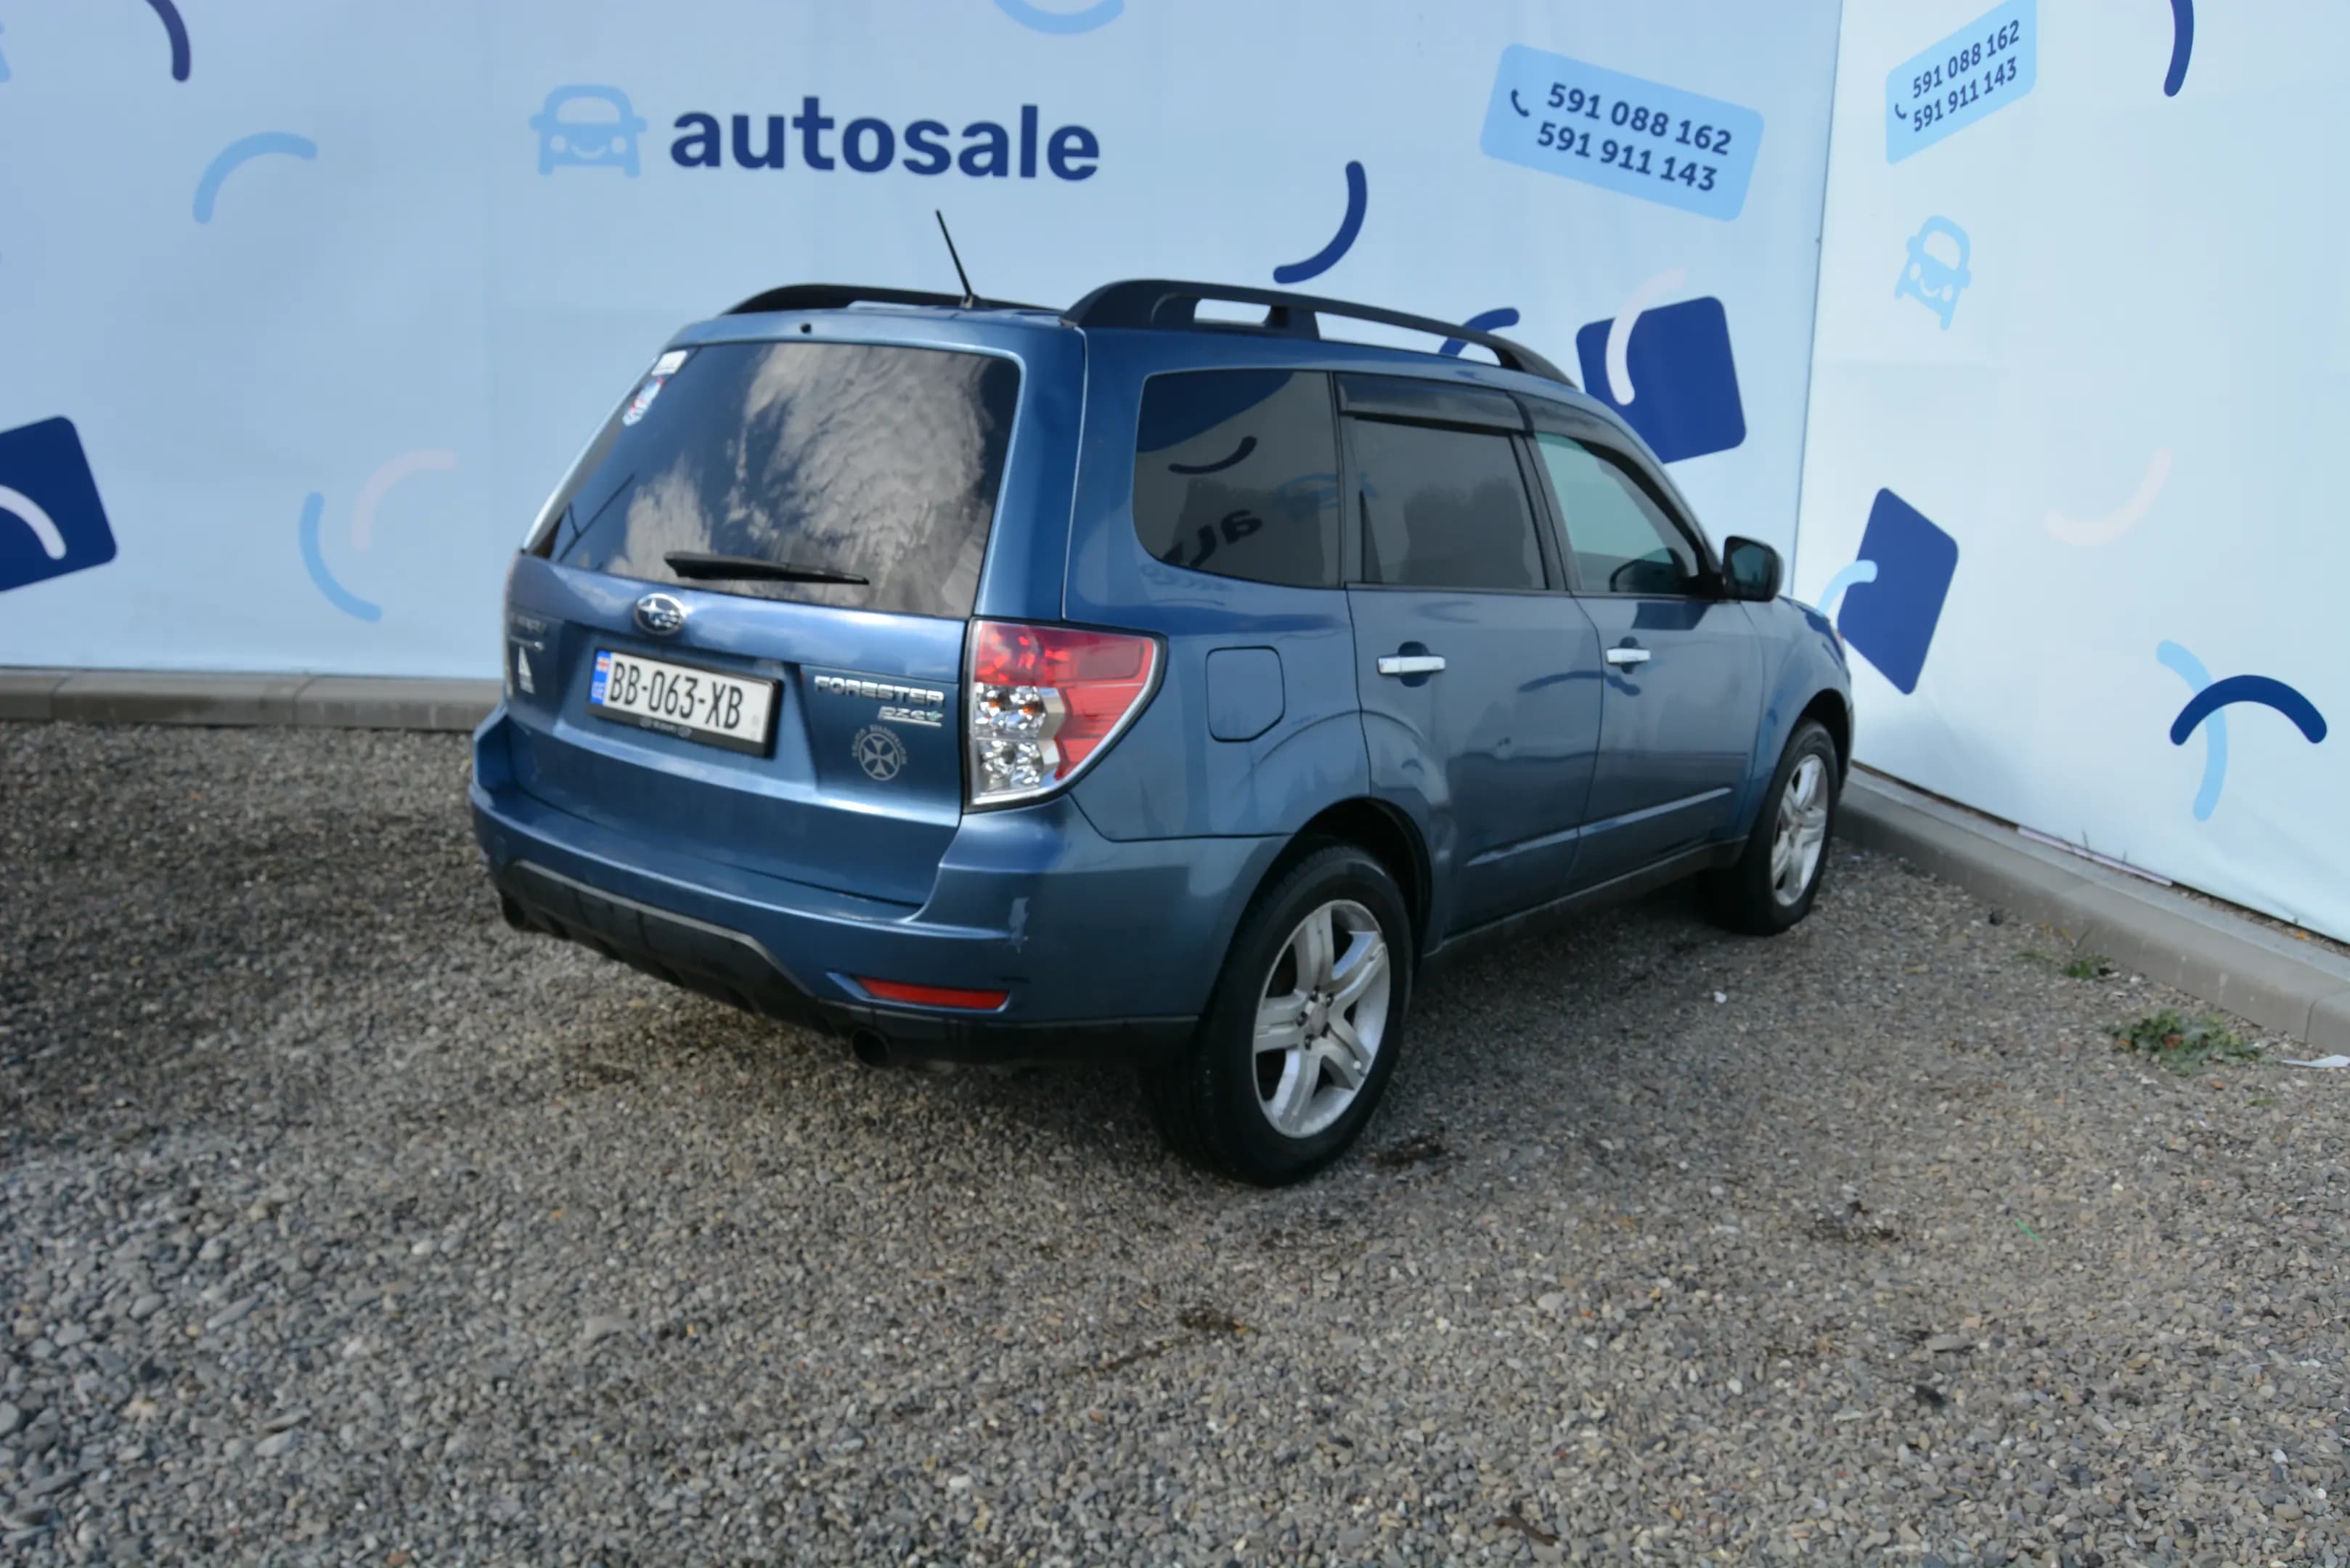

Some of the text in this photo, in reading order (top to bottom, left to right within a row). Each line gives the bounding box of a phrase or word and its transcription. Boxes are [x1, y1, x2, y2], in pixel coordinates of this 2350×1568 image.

[1912, 20, 2020, 99] 591 088 162
[1914, 56, 2017, 132] 591 911 143
[670, 96, 1100, 181] autosale
[1547, 81, 1731, 155] 591 088 162
[1537, 121, 1718, 191] 591 911 143
[609, 661, 743, 730] BB-063-XB
[814, 675, 945, 707] FORESTER
